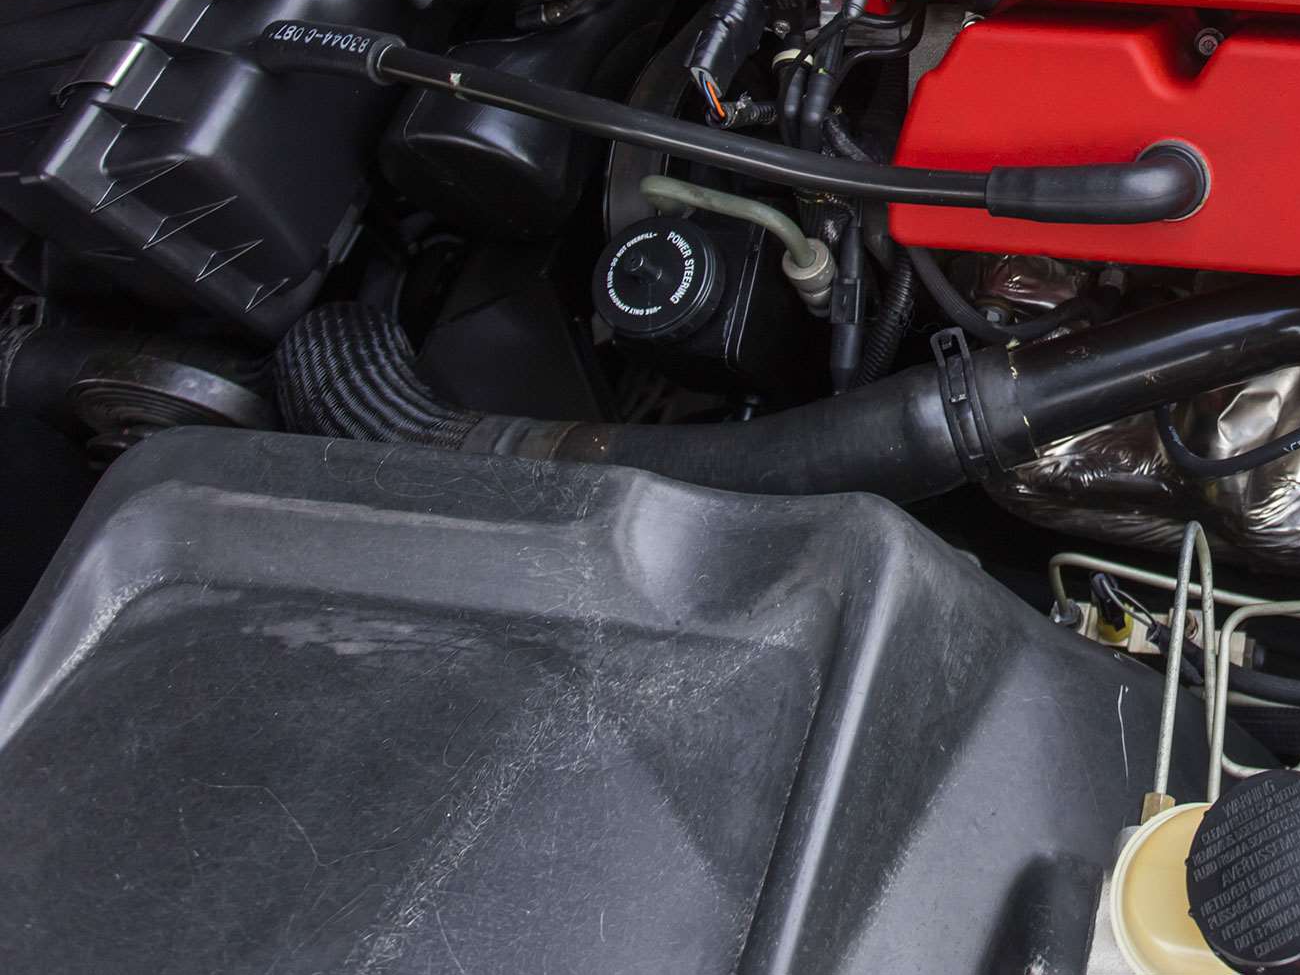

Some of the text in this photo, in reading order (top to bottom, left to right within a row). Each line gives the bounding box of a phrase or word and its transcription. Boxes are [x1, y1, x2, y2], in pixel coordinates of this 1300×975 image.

[667, 231, 694, 304] POWER STEERING
[1223, 780, 1273, 815] WARNING
